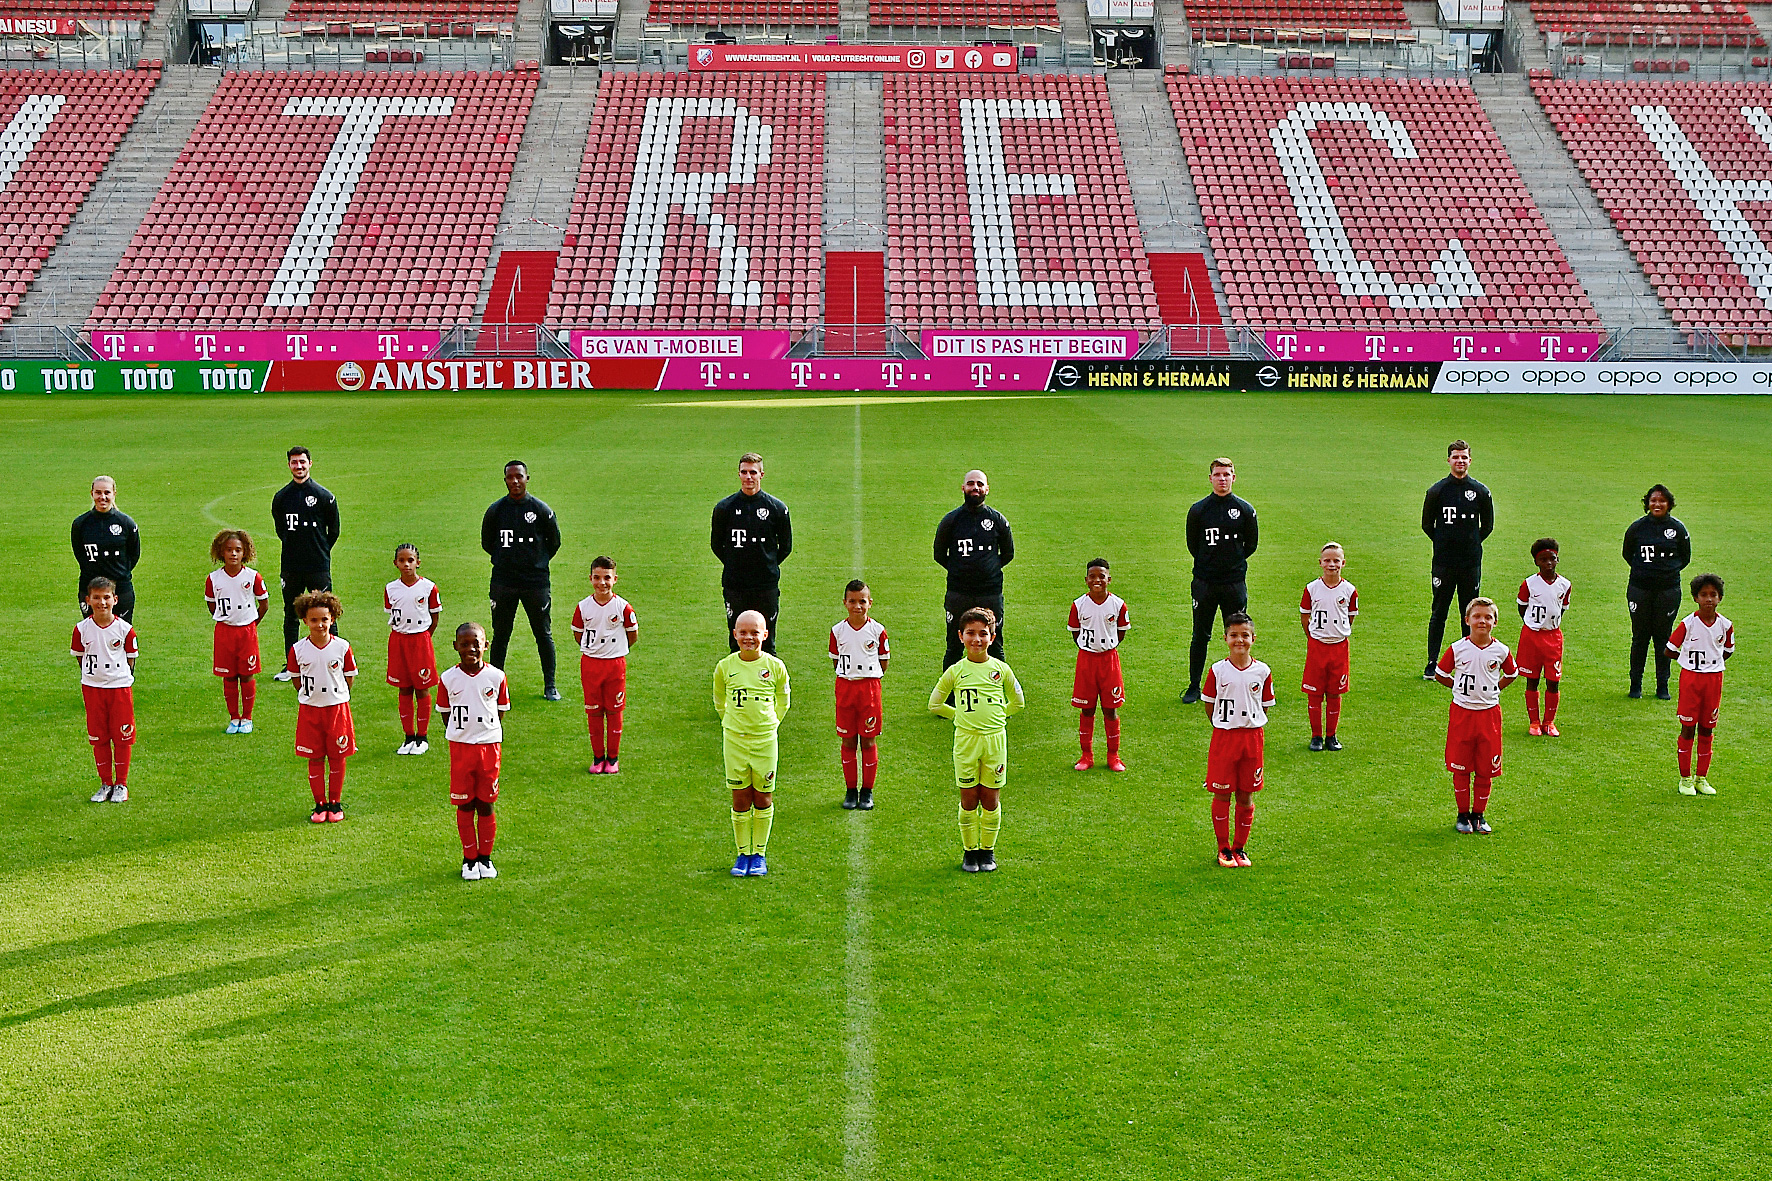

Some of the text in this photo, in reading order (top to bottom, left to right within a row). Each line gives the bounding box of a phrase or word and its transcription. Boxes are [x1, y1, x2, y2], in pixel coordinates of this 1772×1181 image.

[15, 19, 57, 34] NESU
[724, 54, 801, 62] WWW.FCUTRECHT.NL
[831, 54, 840, 62] FC
[841, 54, 874, 63] UTRECHT
[875, 55, 901, 63] ONLINE
[585, 339, 738, 354] 5G VAN T-MOBILE
[937, 339, 1123, 354] DIT IS PAS HET BEGIN
[41, 369, 96, 390] TOTO
[120, 369, 176, 390] TOTO
[199, 369, 254, 390] TOTO
[513, 361, 594, 389] BIER
[1088, 372, 1230, 387] HENRI & HERMAN
[1288, 373, 1429, 388] HENRI & HERMAN
[1445, 370, 1510, 387] oppo
[1522, 370, 1586, 387] oppo
[1597, 370, 1662, 387] oppo
[1673, 371, 1738, 388] oppo
